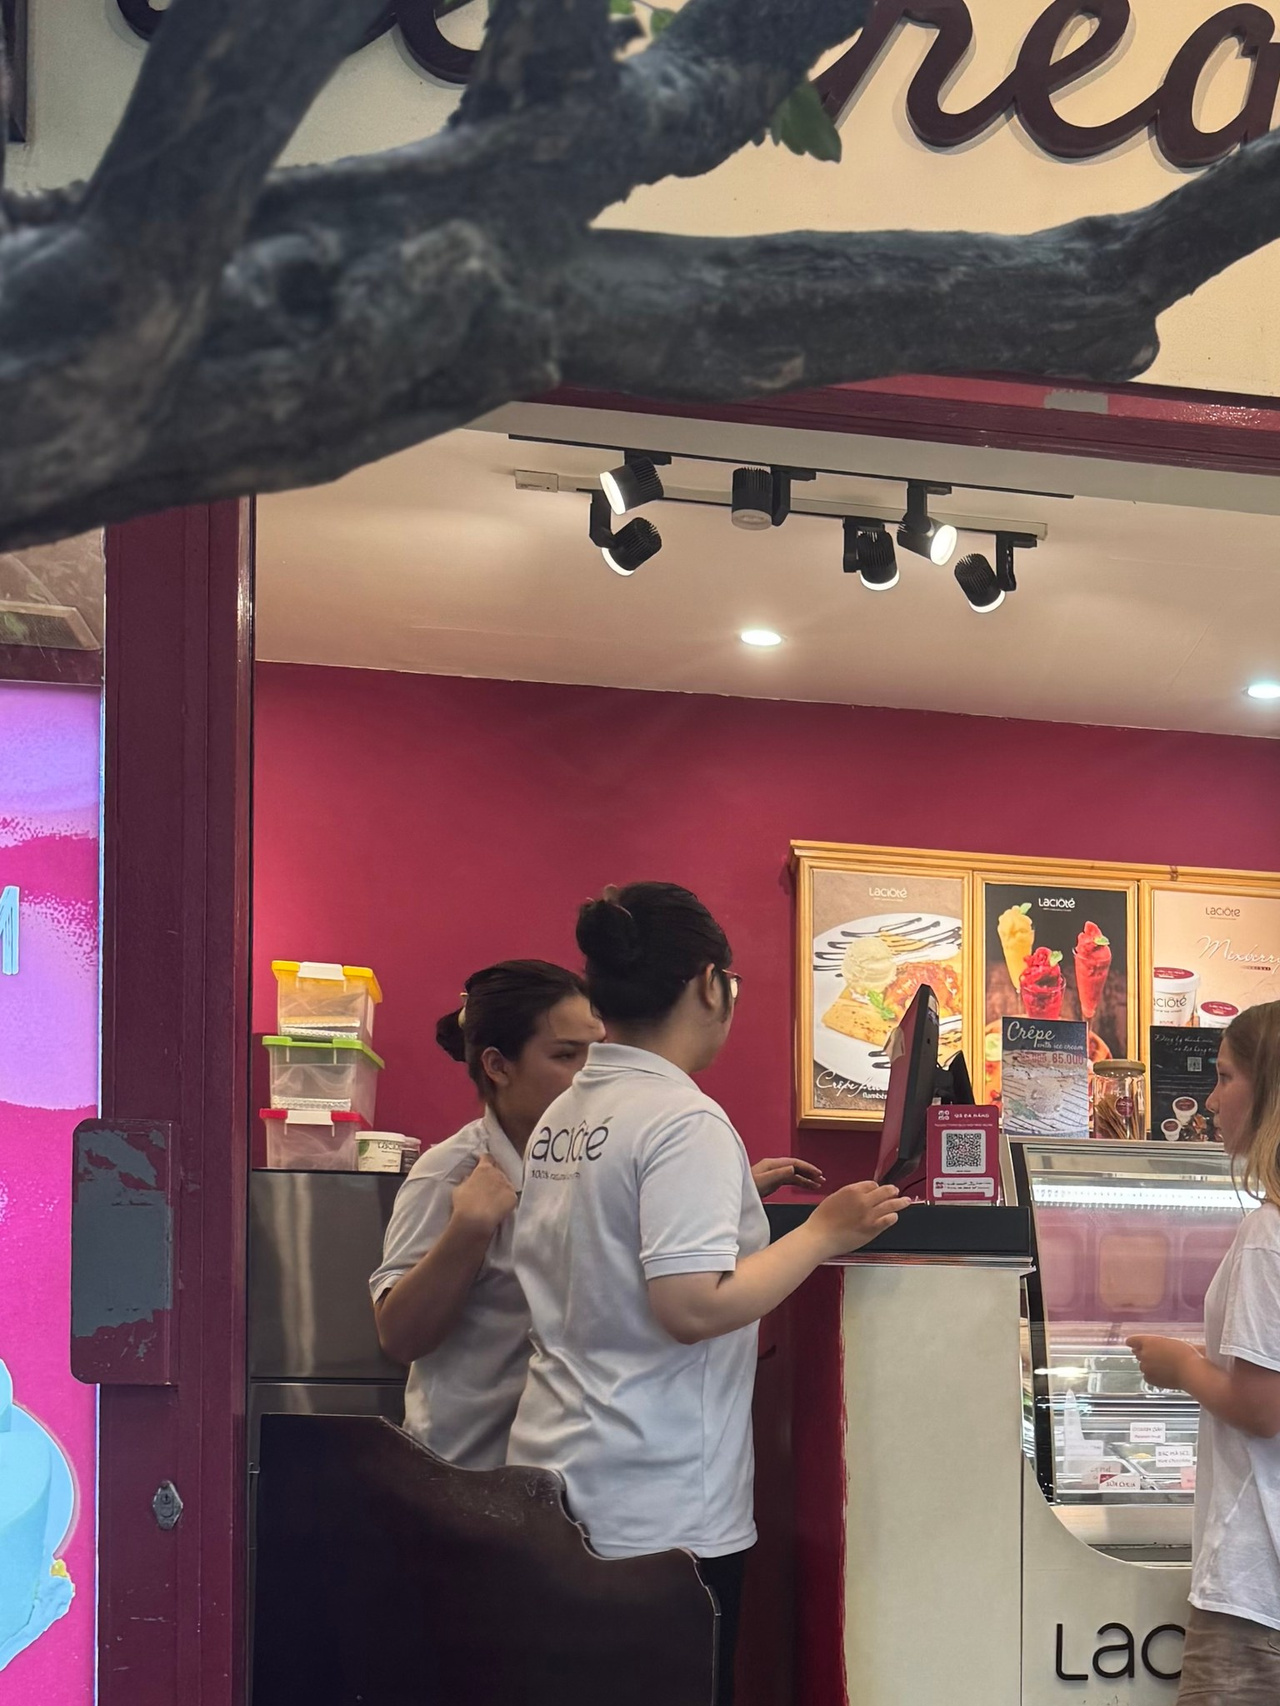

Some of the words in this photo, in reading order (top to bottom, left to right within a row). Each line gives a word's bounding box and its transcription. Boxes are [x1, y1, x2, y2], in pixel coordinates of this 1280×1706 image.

[1007, 1020, 1056, 1049] Crêpe
[1063, 1043, 1084, 1051] cream
[1052, 1053, 1084, 1066] 85.000
[1056, 1622, 1186, 1681] Lac
